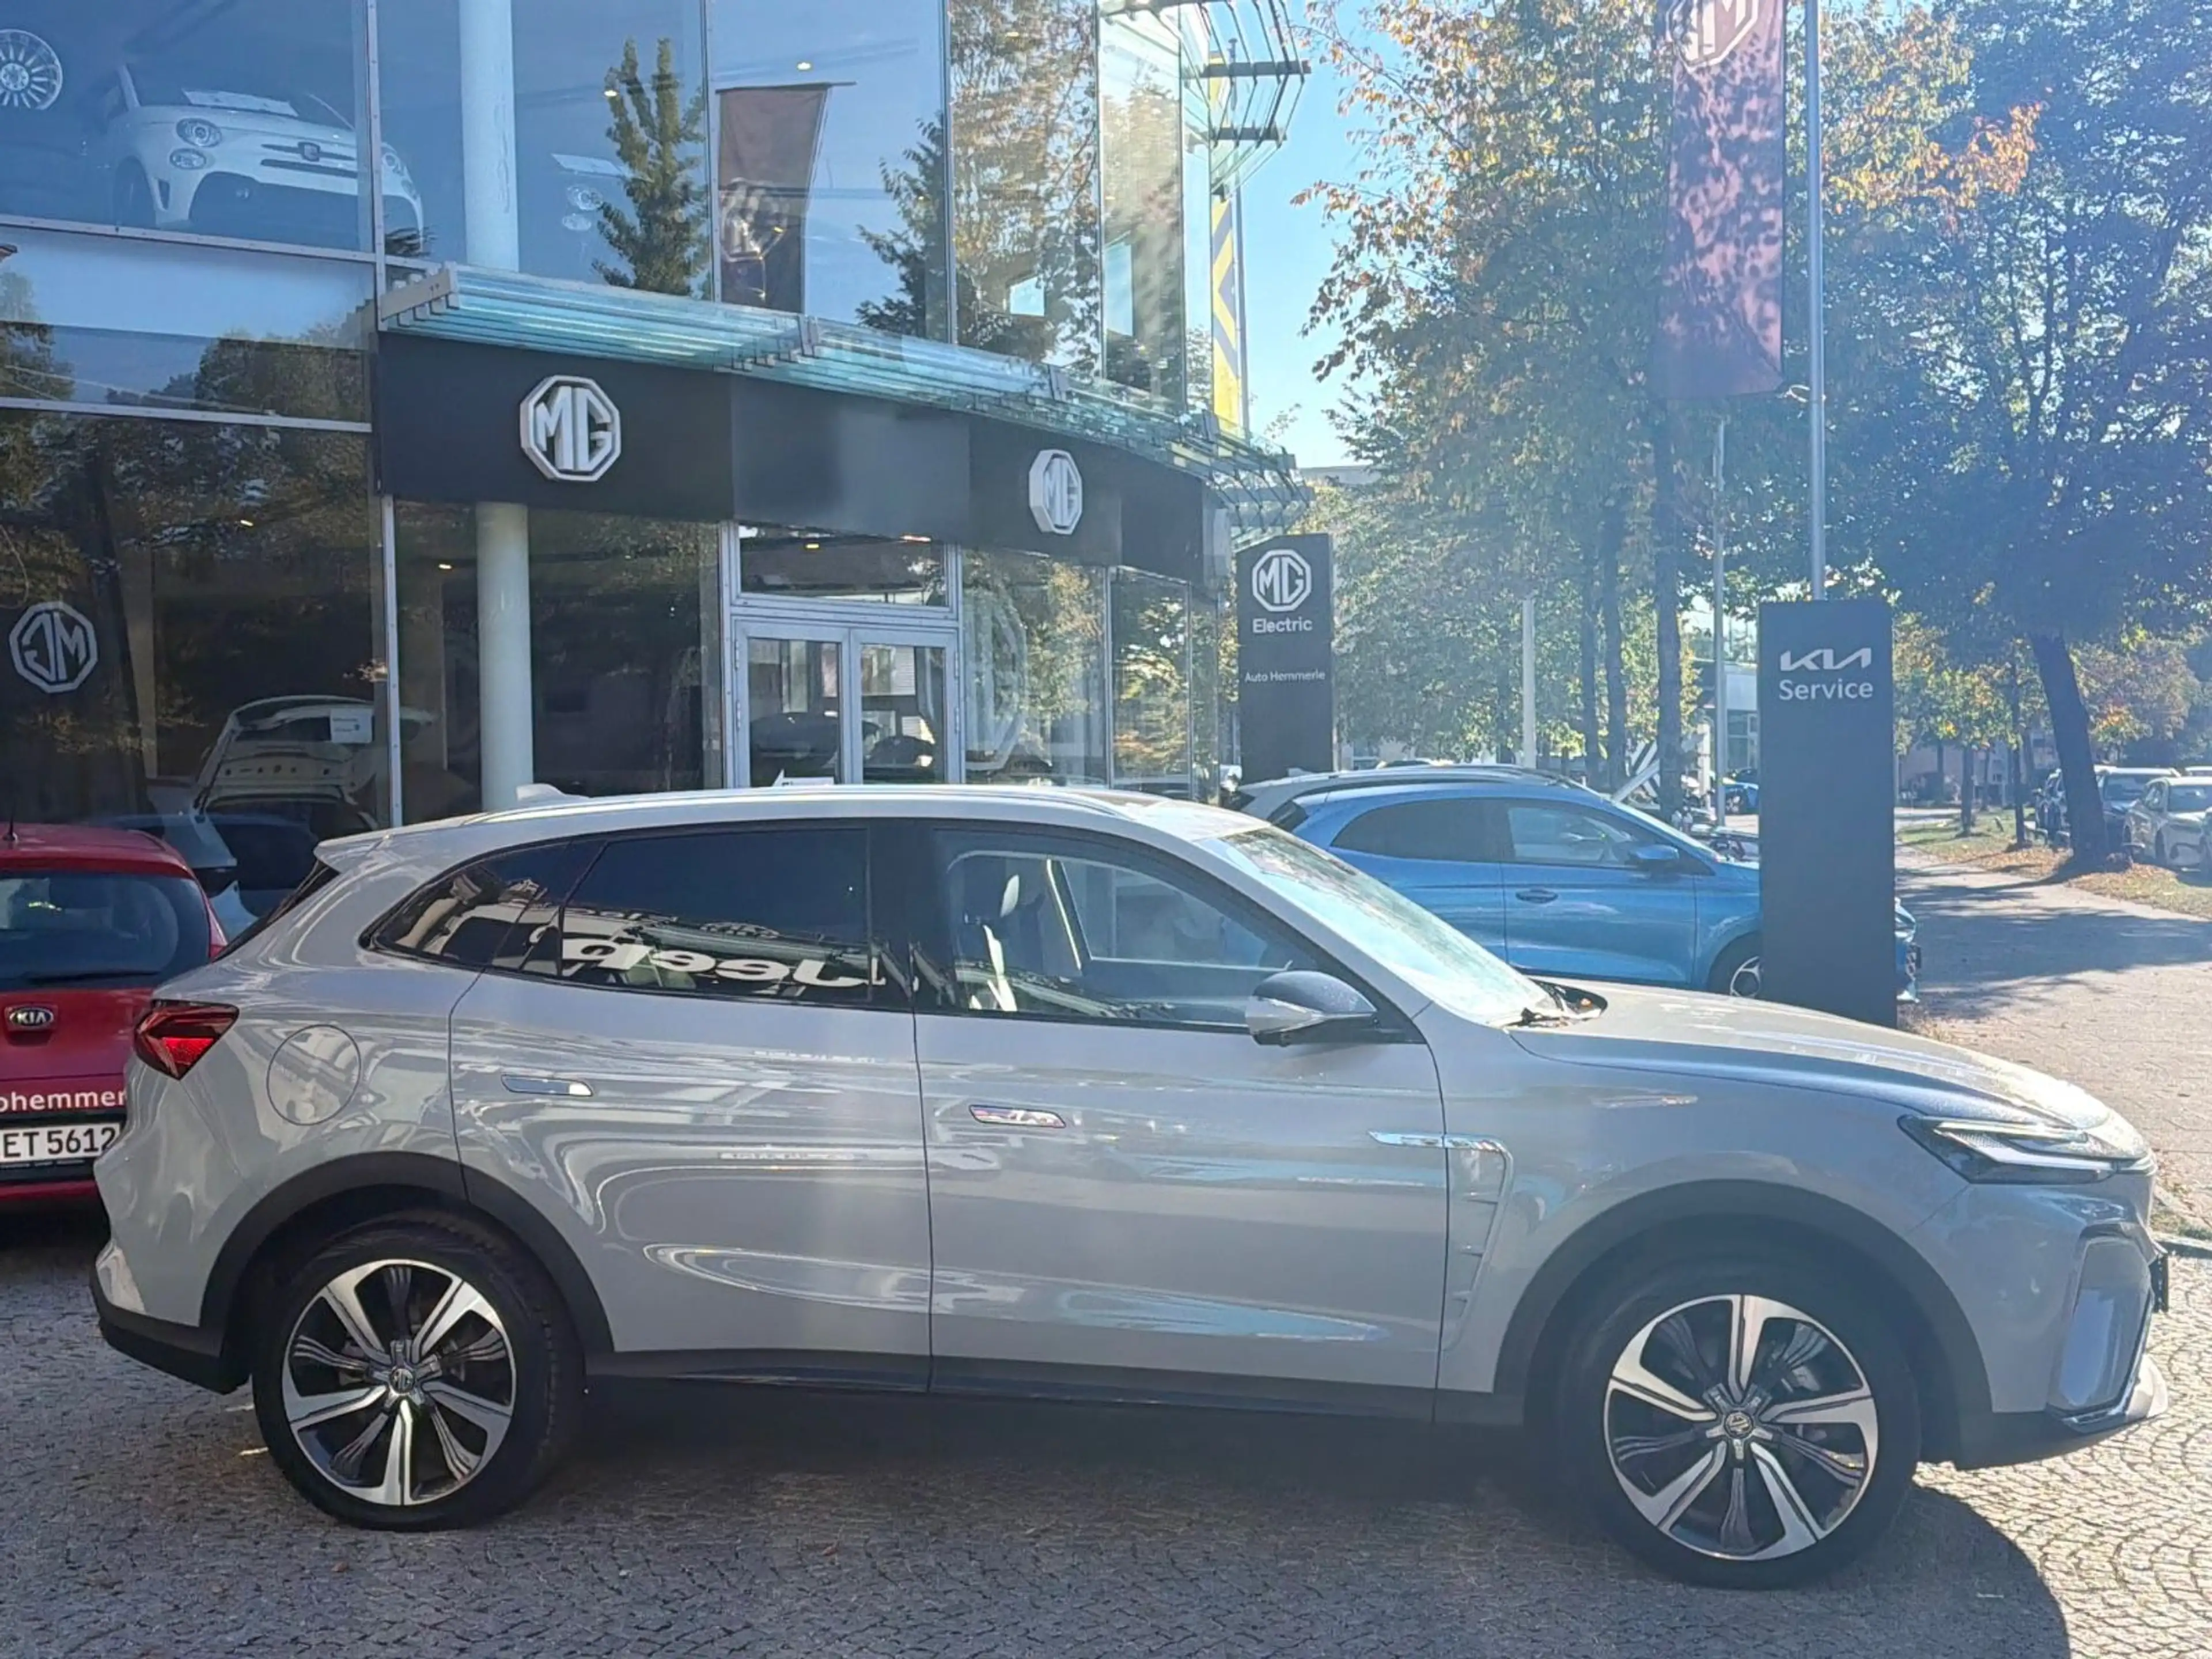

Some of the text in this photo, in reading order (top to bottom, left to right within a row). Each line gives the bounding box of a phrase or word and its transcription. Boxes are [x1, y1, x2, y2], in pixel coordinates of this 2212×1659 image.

[535, 385, 612, 472] MG
[1043, 457, 1080, 527] MG
[1258, 556, 1305, 604] MG
[1252, 616, 1313, 634] Electric
[1780, 647, 1872, 672] KIA
[1244, 669, 1325, 683] Auto Hemmerle
[1778, 678, 1874, 701] Service
[17, 1012, 47, 1024] KIA
[3, 1127, 116, 1158] ET 5612
